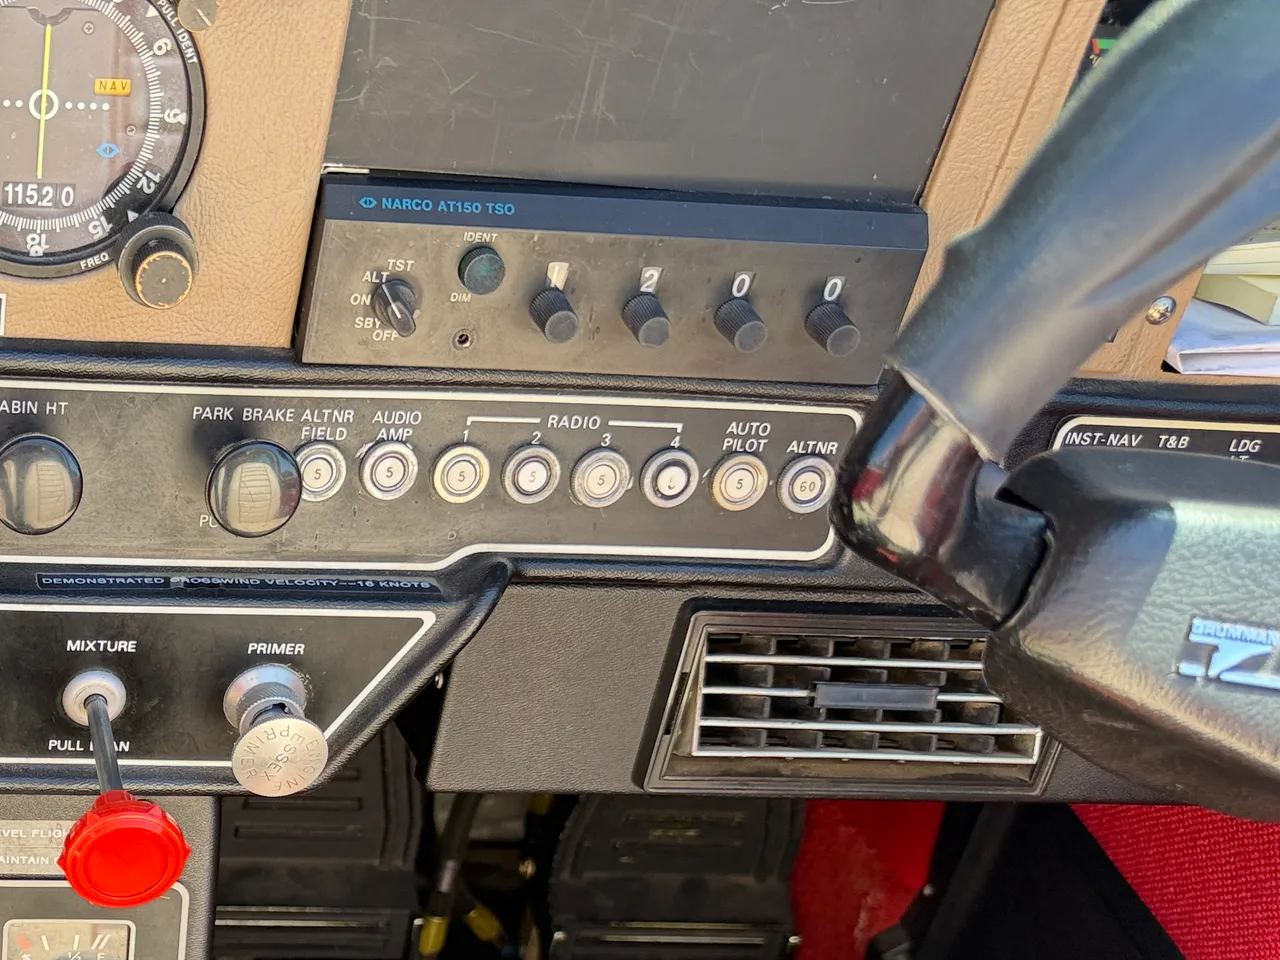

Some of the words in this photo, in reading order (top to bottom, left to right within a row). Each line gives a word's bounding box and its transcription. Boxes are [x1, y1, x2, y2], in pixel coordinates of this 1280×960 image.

[157, 1, 179, 27] PULL
[176, 28, 198, 64] IDENT
[153, 37, 172, 56] 6
[99, 80, 128, 92] NAV
[136, 169, 161, 195] 12
[381, 197, 433, 212] NARCO
[437, 200, 482, 214] AT150
[486, 203, 515, 216] TSO
[87, 215, 113, 240] 15
[463, 230, 499, 243] IDENT
[80, 251, 110, 271] FREQ
[387, 258, 414, 272] TST
[362, 271, 389, 284] ALT
[640, 269, 659, 293] 2
[731, 272, 751, 299] 0
[823, 276, 844, 302] 0
[350, 293, 371, 307] ON
[450, 291, 472, 303] DIM
[354, 317, 382, 329] SBY
[372, 329, 399, 342] OFF
[45, 401, 69, 416] HT
[192, 405, 235, 421] PARK
[241, 407, 296, 423] BRAKE
[300, 408, 356, 424] ALTNR
[372, 410, 422, 426] AUDIO
[546, 414, 601, 430] RADIO
[301, 426, 348, 441] FIELD
[375, 427, 414, 442] AMP
[725, 422, 771, 437] AUTO
[531, 431, 542, 445] 2
[601, 433, 612, 447] 3
[670, 435, 682, 449] 4
[722, 438, 768, 453] PILOT
[1065, 431, 1143, 447] INST-NAV
[1158, 435, 1191, 449] T&B
[786, 440, 839, 455] ALTNR
[1228, 439, 1263, 453] LDG
[800, 480, 816, 493] 60
[41, 576, 165, 586] DEMONSTRATED
[379, 581, 431, 590] KNOTS
[66, 639, 137, 653] MIXTURE
[247, 642, 305, 656] PRIMER
[48, 739, 84, 751] PULL
[262, 732, 306, 781] ESSEX
